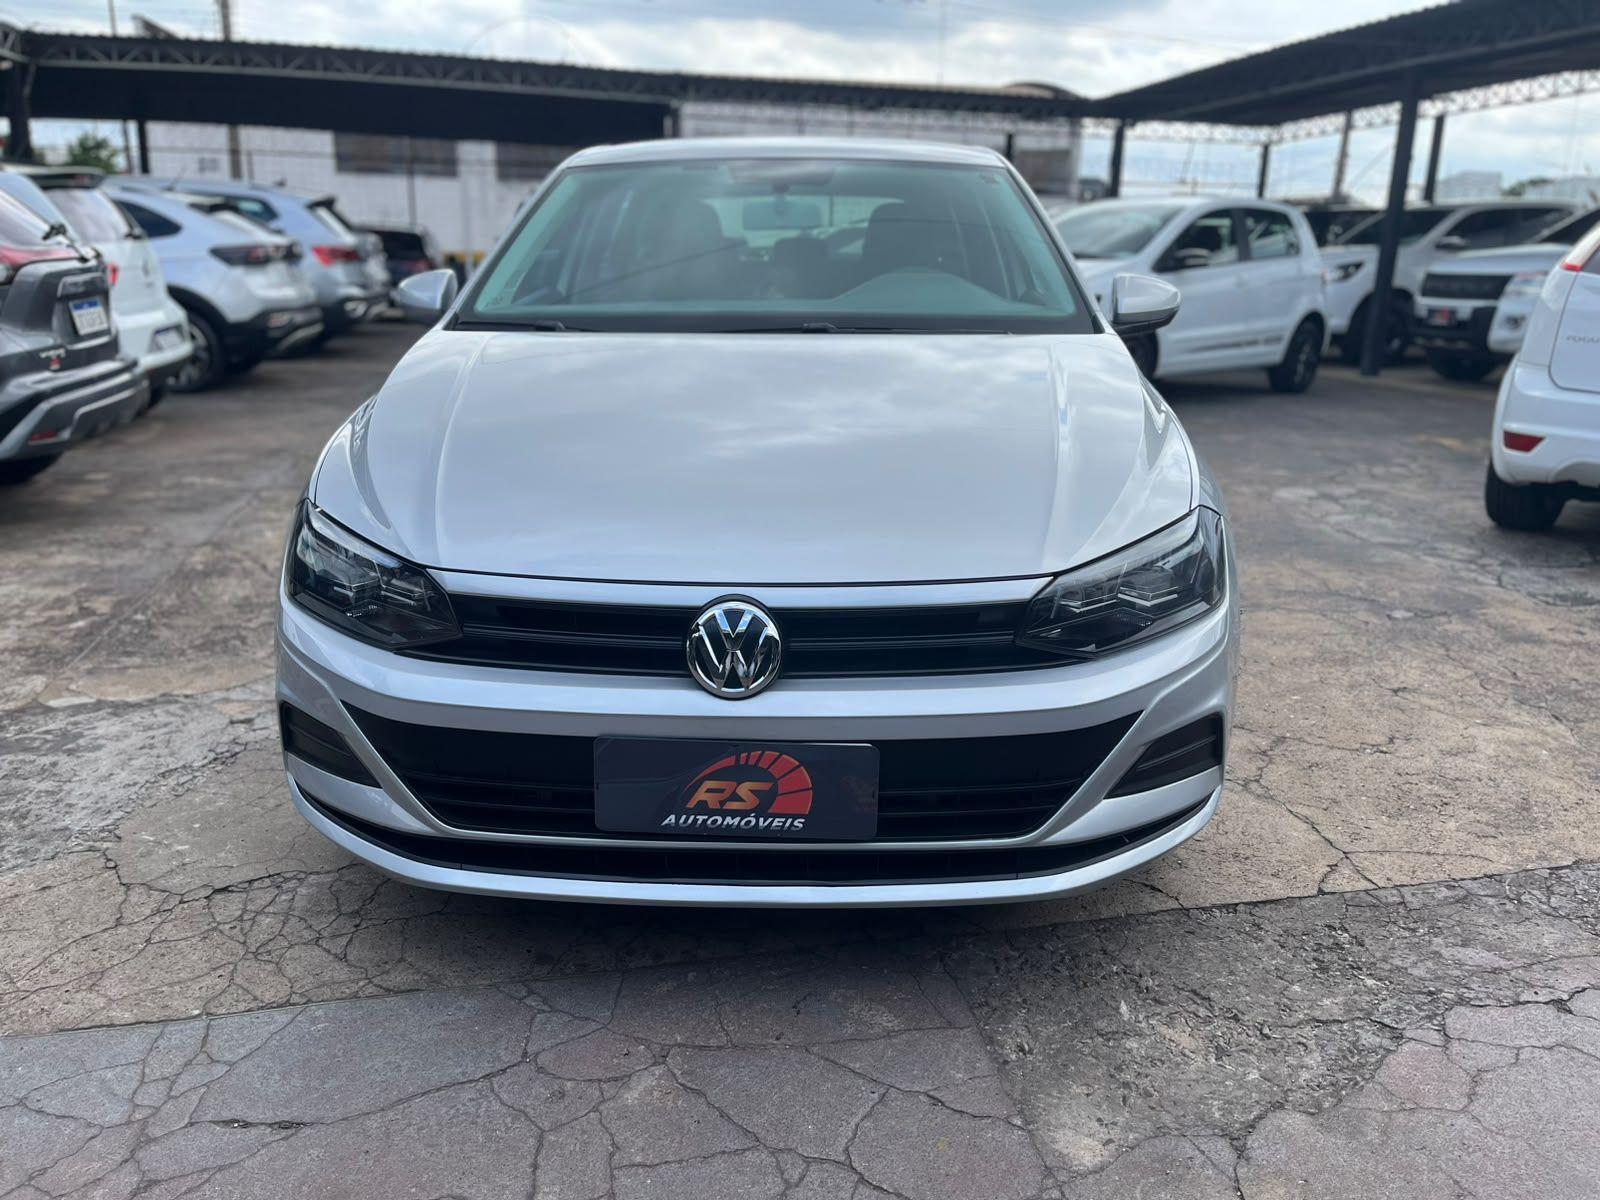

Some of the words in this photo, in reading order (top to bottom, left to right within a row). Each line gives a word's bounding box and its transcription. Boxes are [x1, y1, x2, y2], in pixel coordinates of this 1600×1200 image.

[695, 606, 772, 692] VW
[686, 780, 774, 810] RS
[661, 813, 806, 831] AUTOMÓVEIS
